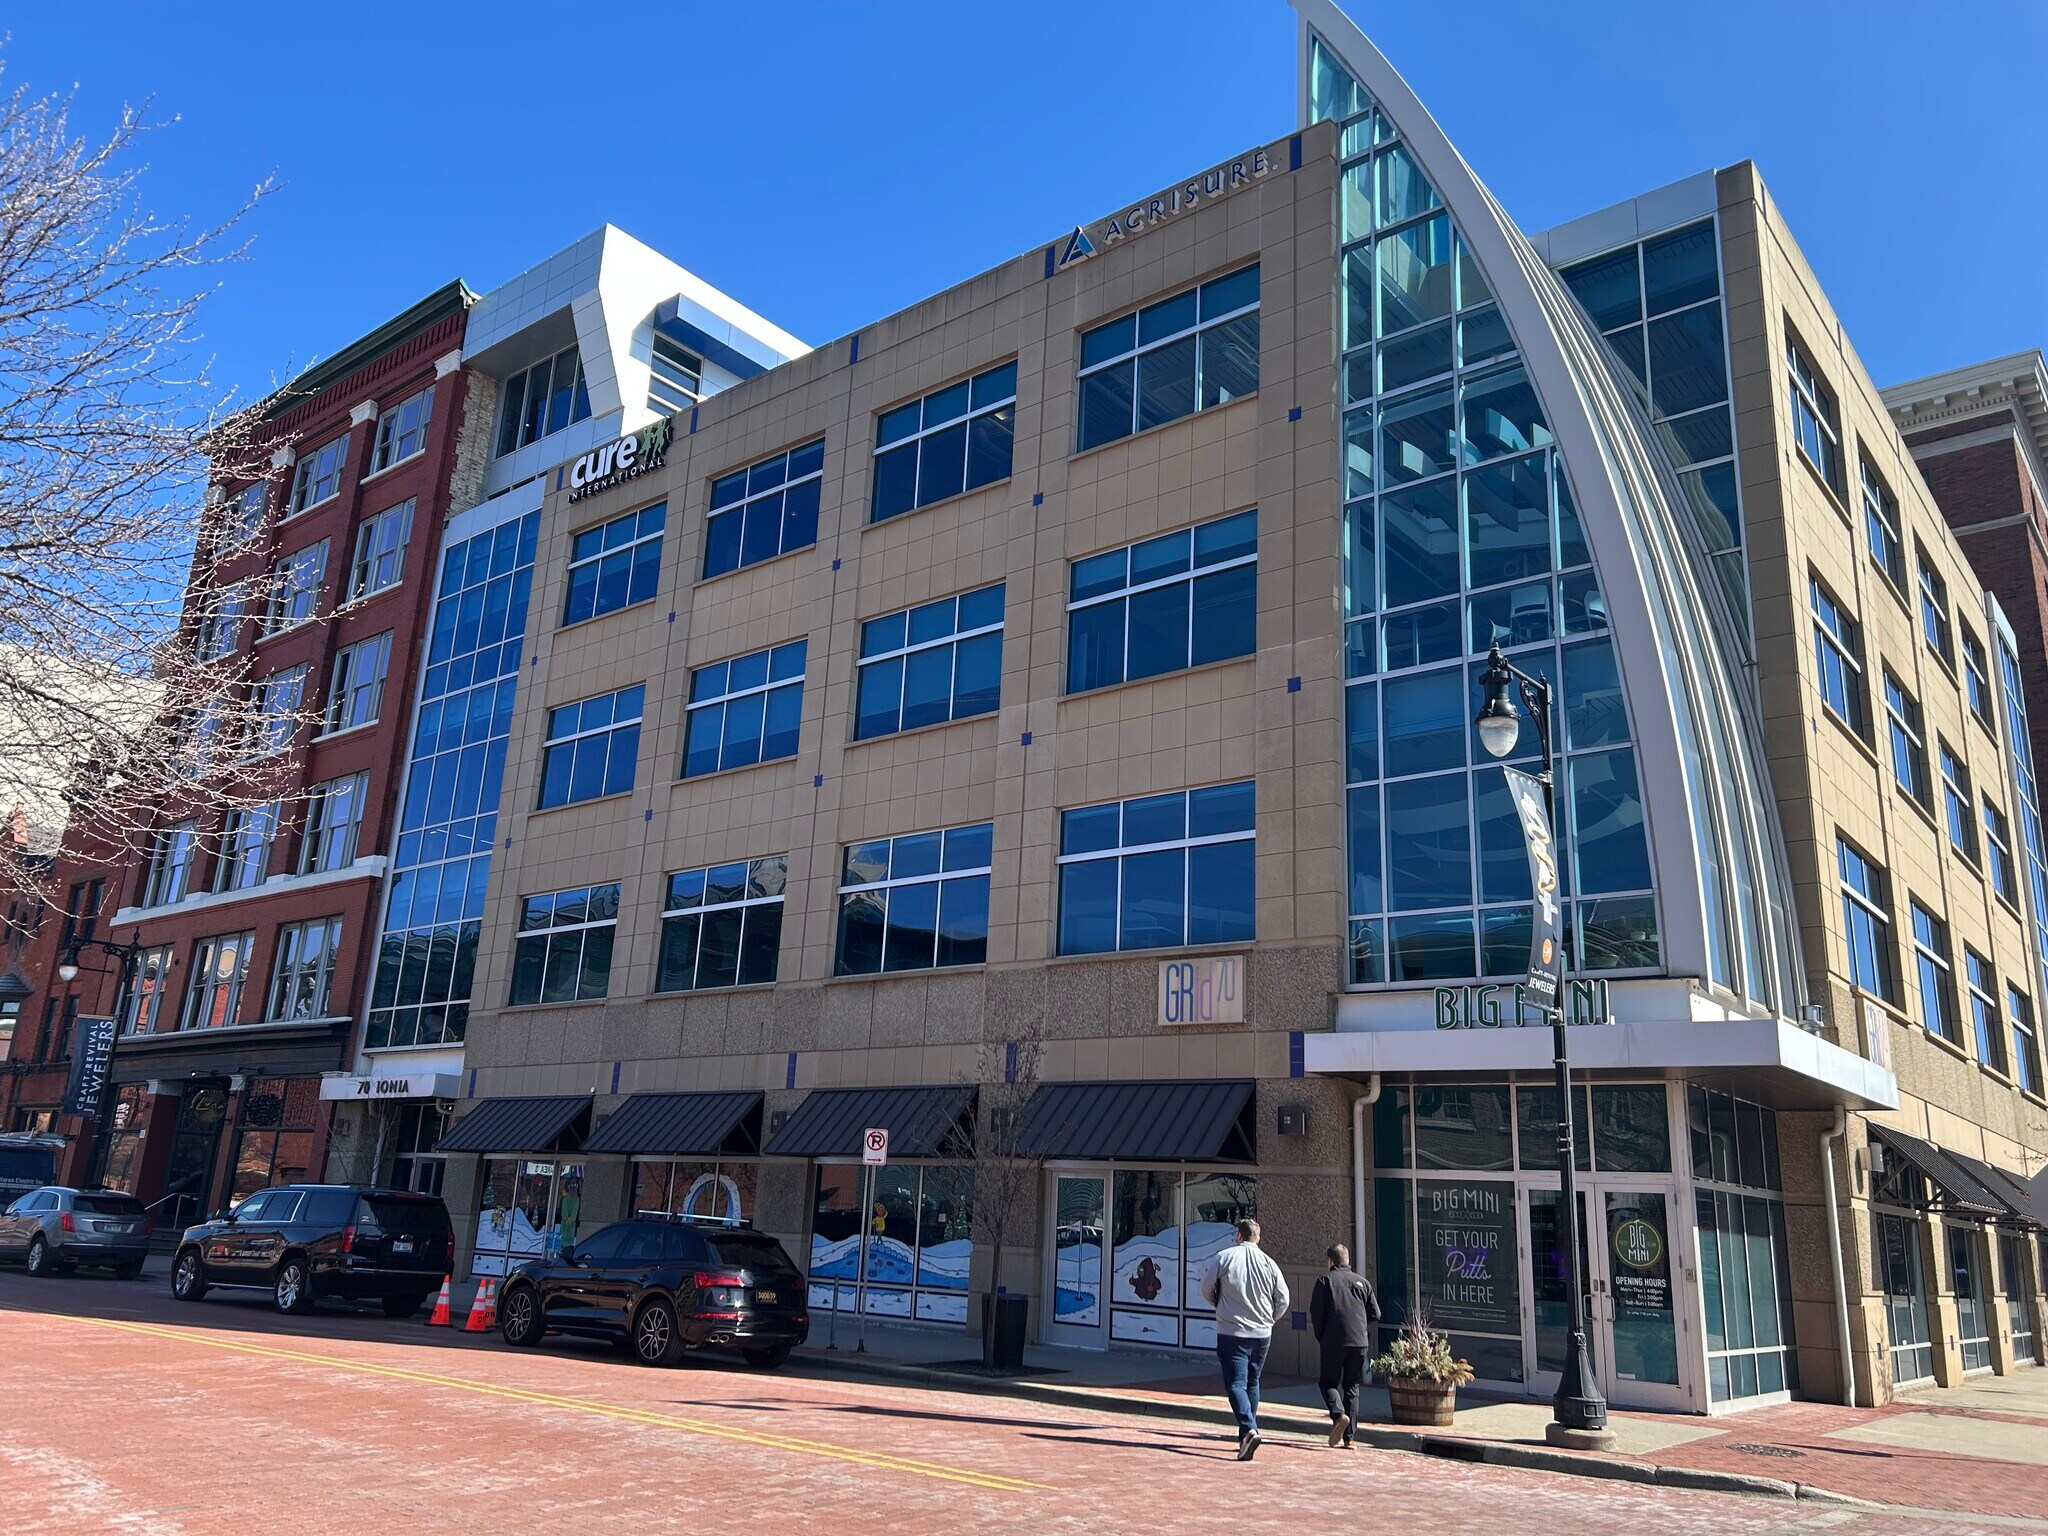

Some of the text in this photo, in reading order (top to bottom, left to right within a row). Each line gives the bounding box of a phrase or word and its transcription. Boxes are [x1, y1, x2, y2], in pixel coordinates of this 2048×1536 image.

[570, 435, 638, 489] cure
[566, 457, 664, 504] INTERNATIONAL
[1528, 977, 1556, 996] JEWELERS
[1434, 979, 1611, 1029] BIG MNI
[76, 1024, 98, 1110] CRAFT-REVIVAL
[84, 1021, 113, 1116] JEWELERS
[357, 1080, 409, 1094] 70 IONIA
[1433, 1188, 1500, 1215] BIG MINI
[1435, 1229, 1499, 1250] GET YOUR
[1629, 1220, 1646, 1249] BIG
[1446, 1250, 1492, 1280] Putts
[1628, 1249, 1650, 1262] MINI
[1443, 1283, 1495, 1304] IN HERE
[1615, 1276, 1667, 1288] OPENING HOURS
